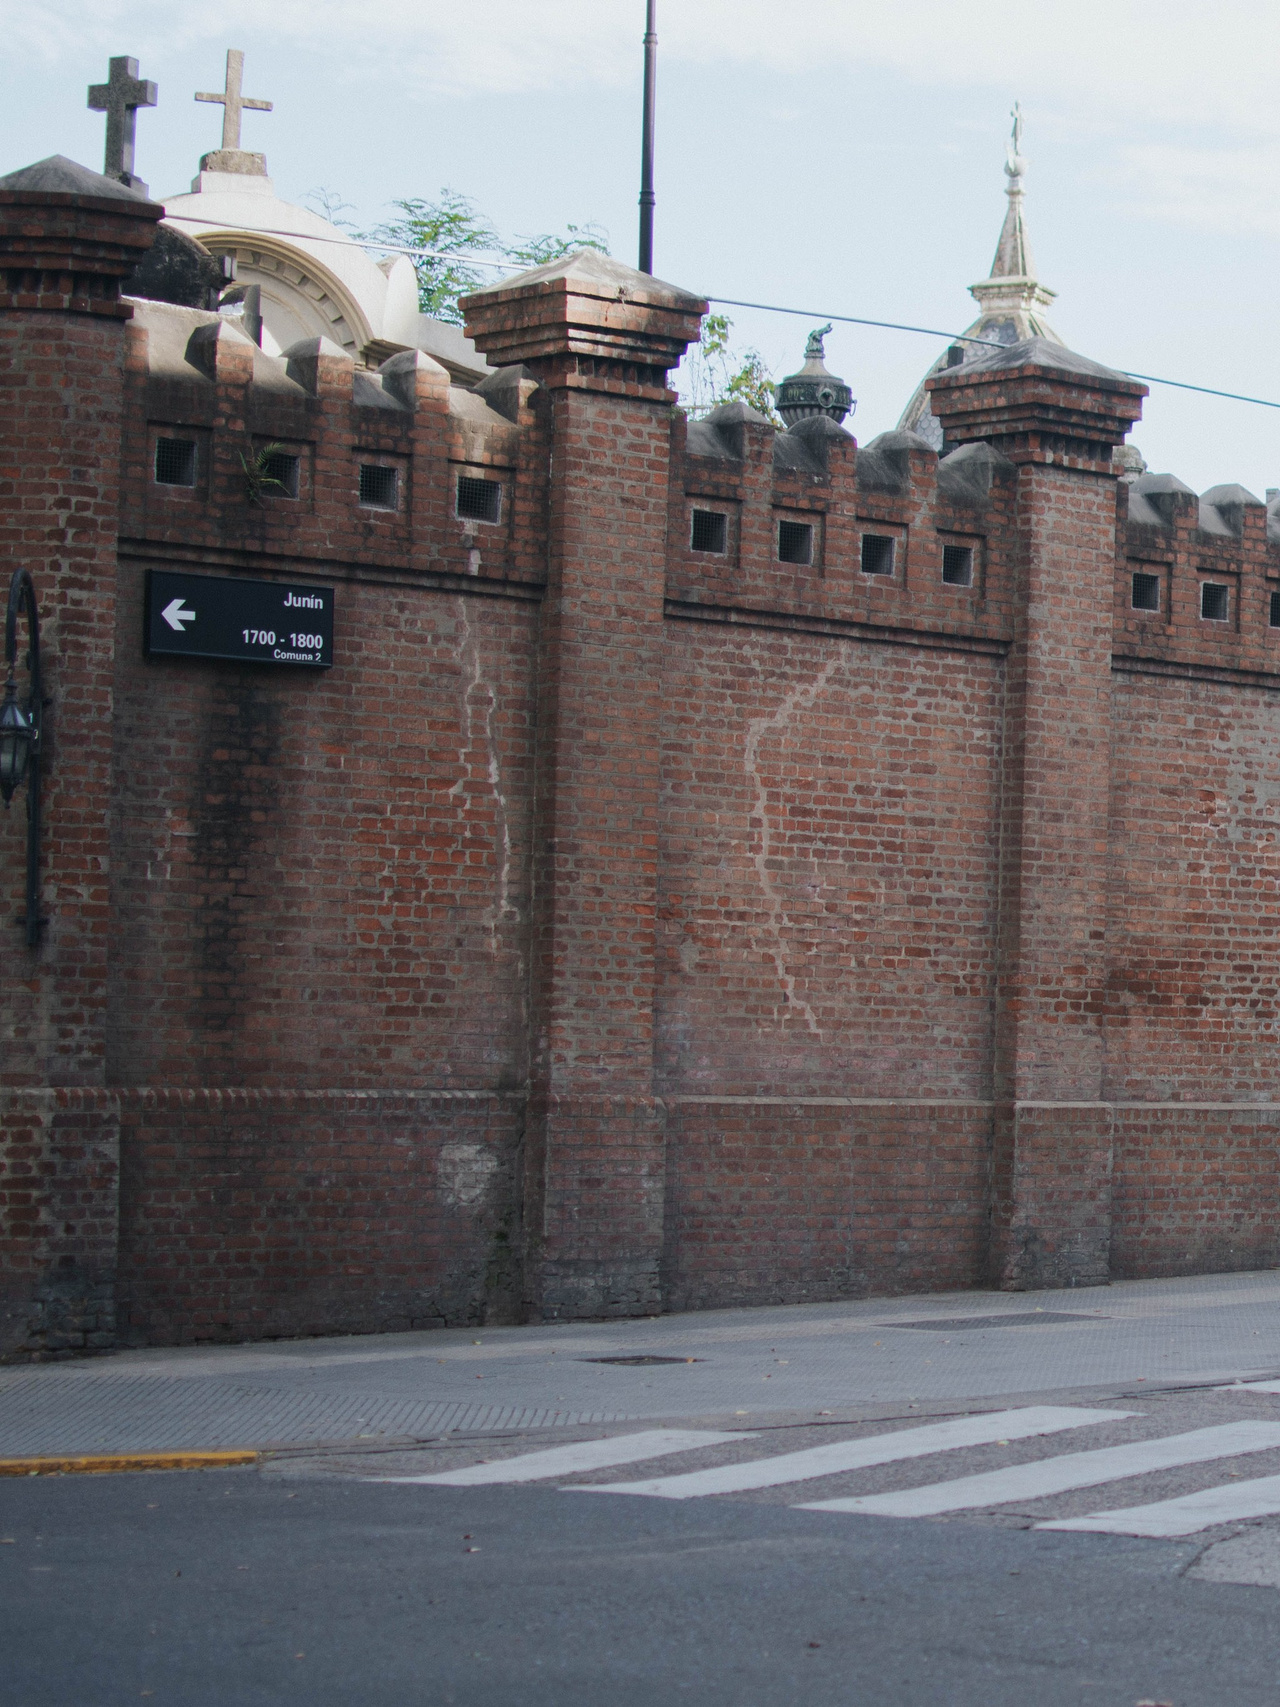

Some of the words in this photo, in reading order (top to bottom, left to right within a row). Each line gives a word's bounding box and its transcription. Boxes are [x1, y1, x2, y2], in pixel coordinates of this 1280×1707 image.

[284, 592, 323, 609] Junín
[242, 629, 276, 645] 1700
[290, 633, 323, 649] 1800
[274, 649, 313, 661] Comuna
[315, 653, 321, 662] 2
